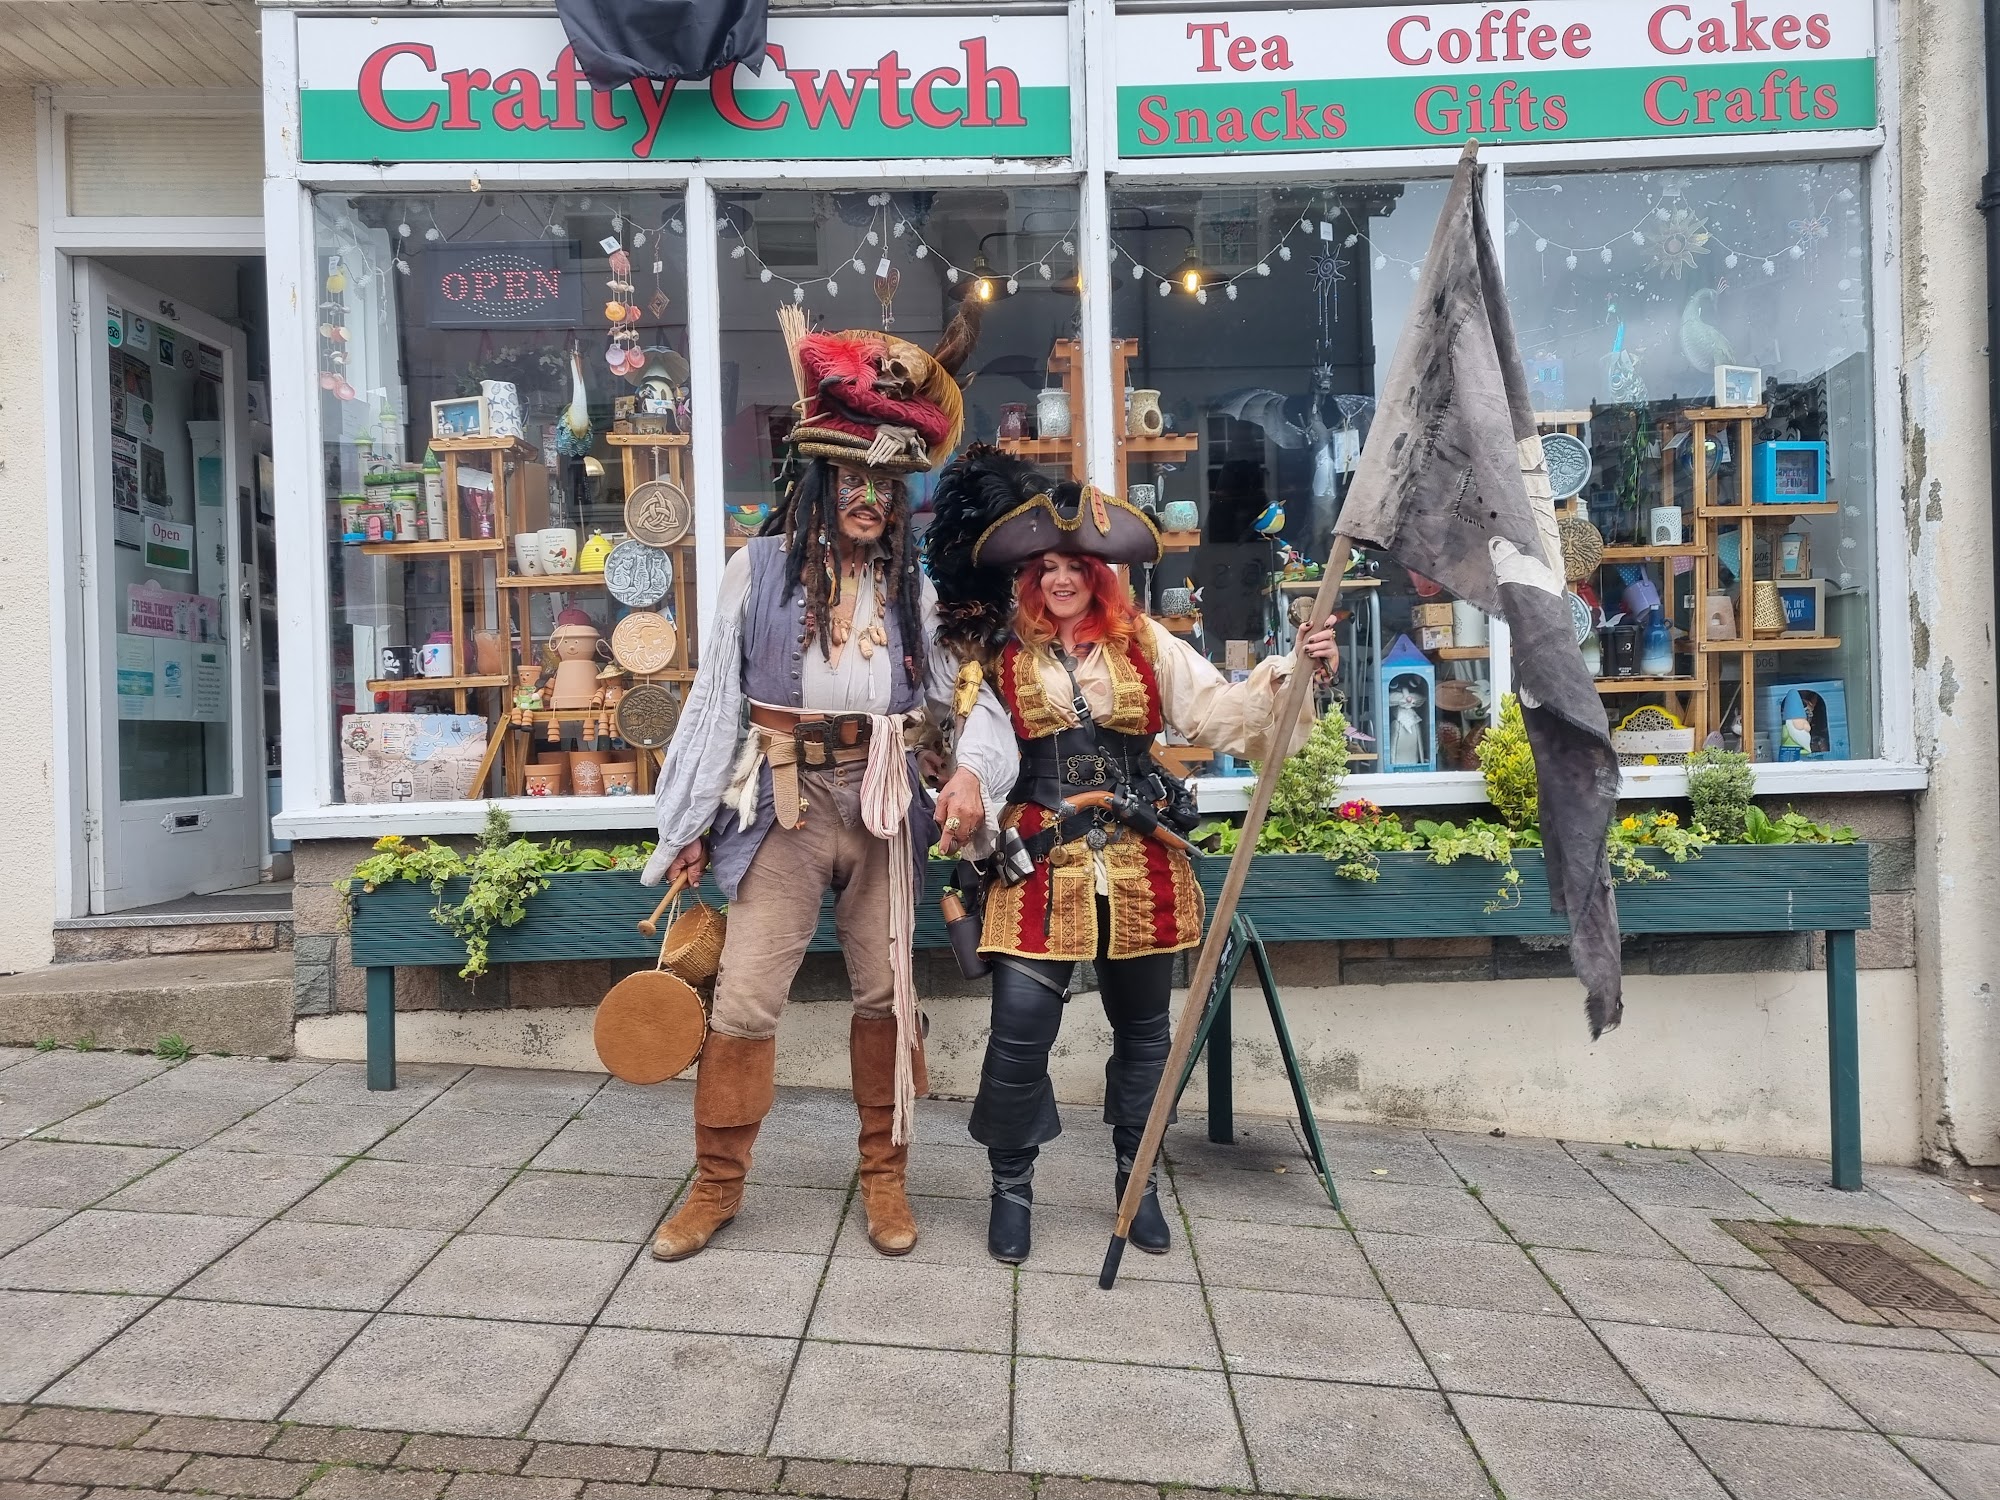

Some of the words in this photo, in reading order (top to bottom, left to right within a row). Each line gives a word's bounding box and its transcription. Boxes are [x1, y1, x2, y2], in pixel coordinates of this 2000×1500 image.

[1186, 21, 1293, 72] Tea
[1386, 13, 1592, 66] Coffee
[1647, 1, 1831, 55] Cakes
[709, 36, 1027, 131] Cwtch
[1137, 88, 1347, 146] Snacks
[1413, 80, 1568, 135] Gifts
[1643, 69, 1839, 126] Crafts
[441, 270, 561, 301] OPEN
[152, 523, 181, 542] Open
[131, 613, 173, 632] MILKSHAKES
